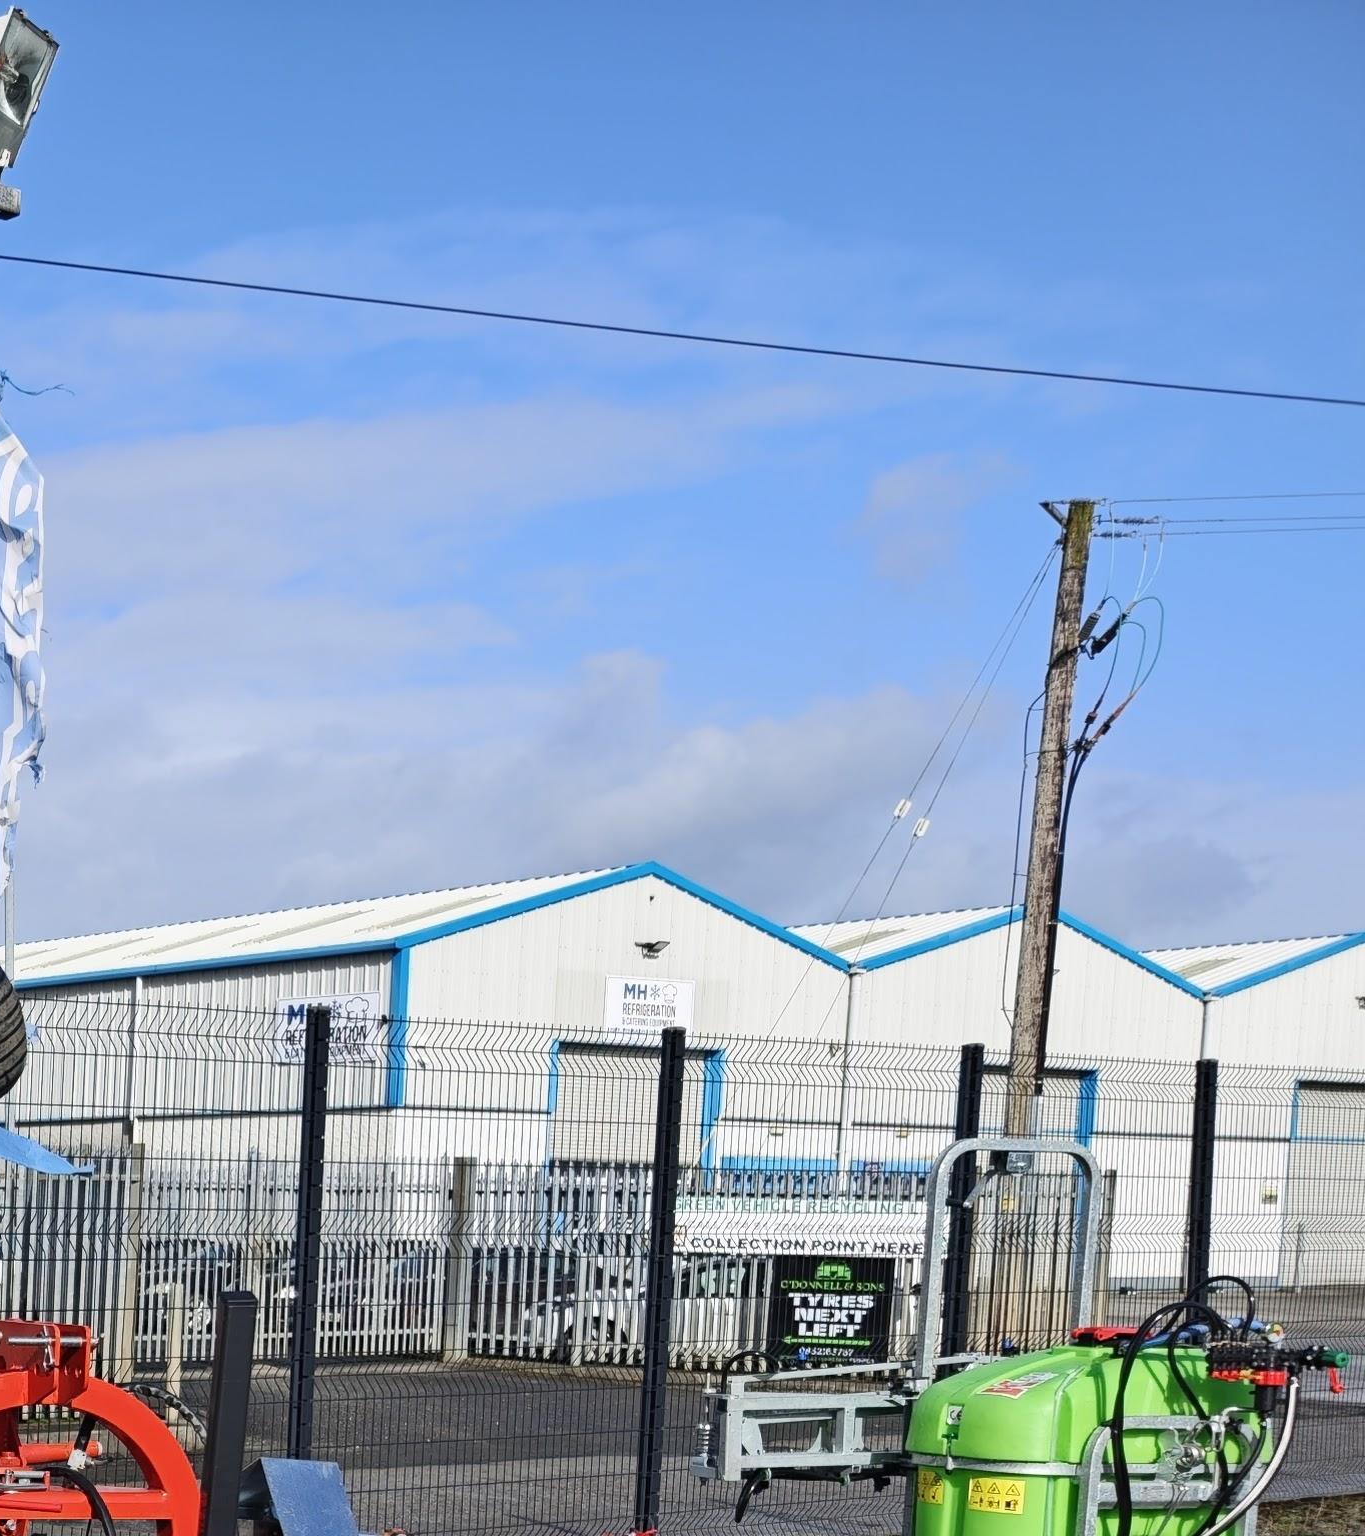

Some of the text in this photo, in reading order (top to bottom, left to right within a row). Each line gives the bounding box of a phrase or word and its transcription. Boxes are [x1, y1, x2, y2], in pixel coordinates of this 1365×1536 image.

[623, 983, 648, 1000] MH
[622, 1002, 677, 1018] REFRIGERATION
[626, 1017, 649, 1026] CATERING
[649, 1018, 675, 1028] EQUIPMENT
[285, 1025, 367, 1046] REFRATION
[733, 1200, 801, 1213] VEHICLE
[809, 1200, 903, 1214] RECYCLING
[690, 1237, 924, 1255] COLLECTION POINT HERE
[856, 1282, 886, 1292] SONS
[788, 1292, 874, 1309] TYRES
[794, 1308, 867, 1323] NEXT
[798, 1322, 861, 1338] LEFT
